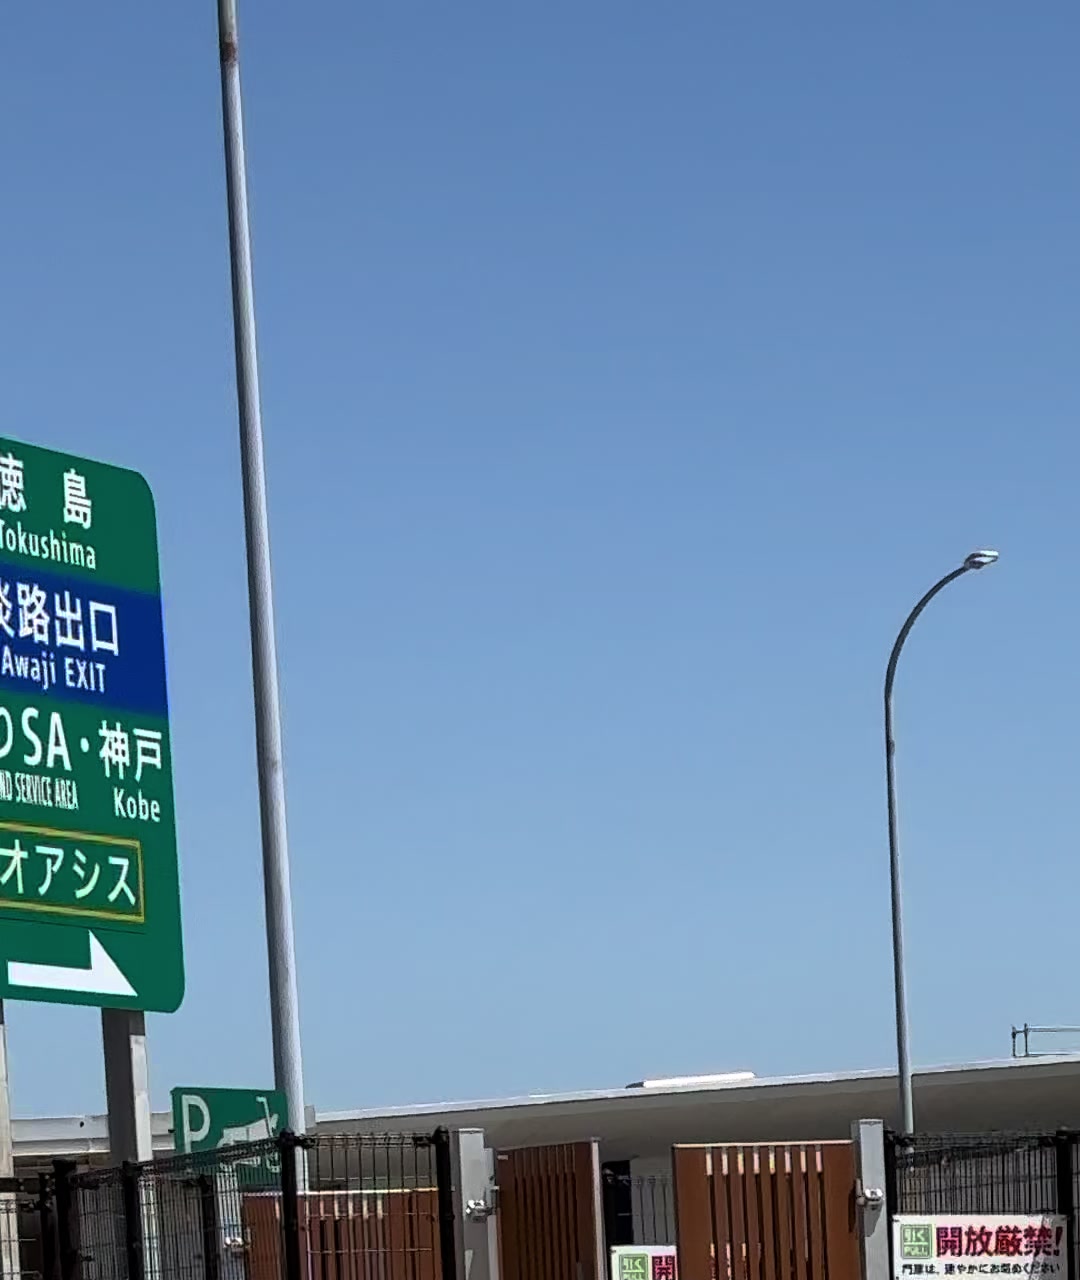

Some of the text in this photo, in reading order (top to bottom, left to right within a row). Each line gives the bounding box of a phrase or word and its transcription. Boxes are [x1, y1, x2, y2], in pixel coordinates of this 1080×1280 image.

[2, 645, 106, 693] Awaji EXIT
[15, 771, 53, 807] SERVICE
[55, 777, 79, 810] AREA
[113, 787, 160, 822] Kobe
[0, 839, 136, 905] オアシス
[182, 1094, 211, 1153] P
